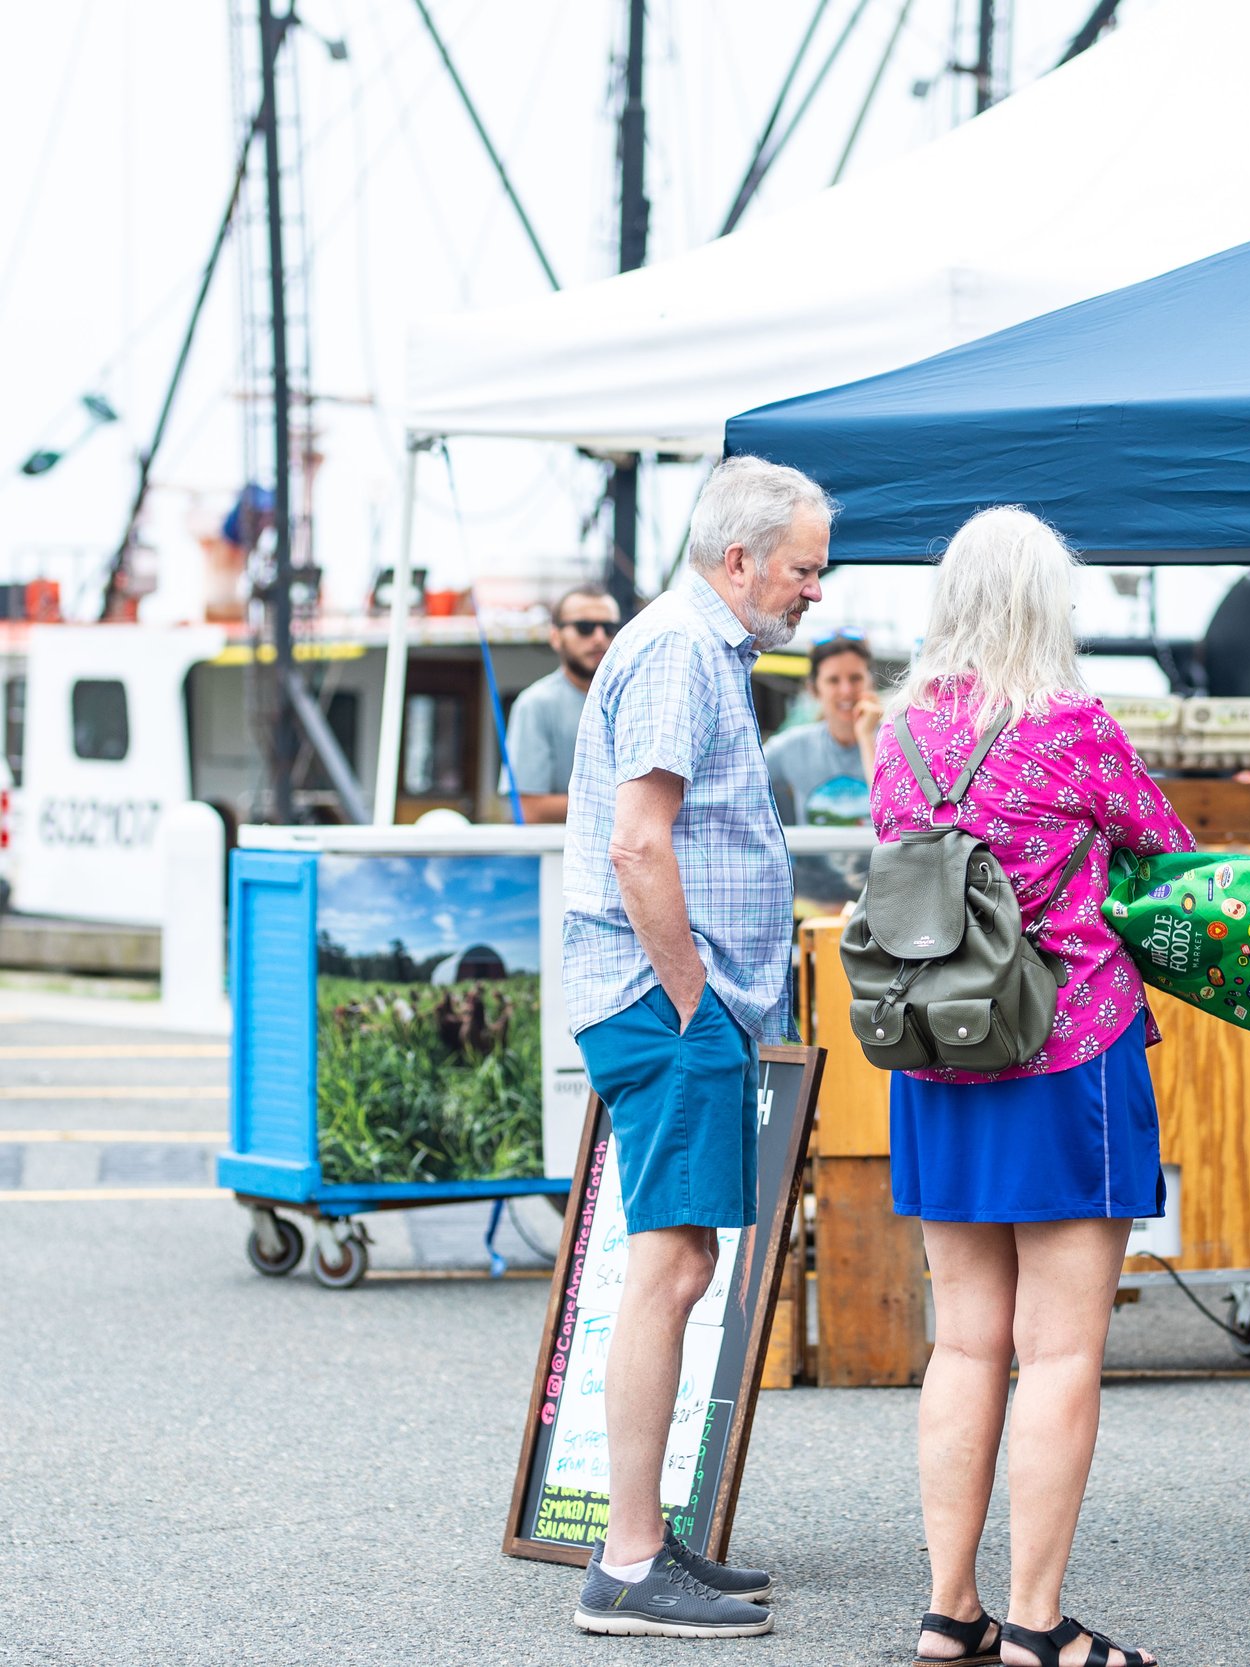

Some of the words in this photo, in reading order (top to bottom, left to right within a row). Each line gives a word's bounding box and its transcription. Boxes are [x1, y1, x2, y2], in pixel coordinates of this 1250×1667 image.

[1142, 914, 1174, 967] WHOLE
[1169, 919, 1193, 973] FOODS
[1192, 931, 1203, 969] MARKET
[539, 1498, 585, 1520] SMOKED
[535, 1519, 586, 1541] SALMON
[673, 1515, 695, 1536] $14
